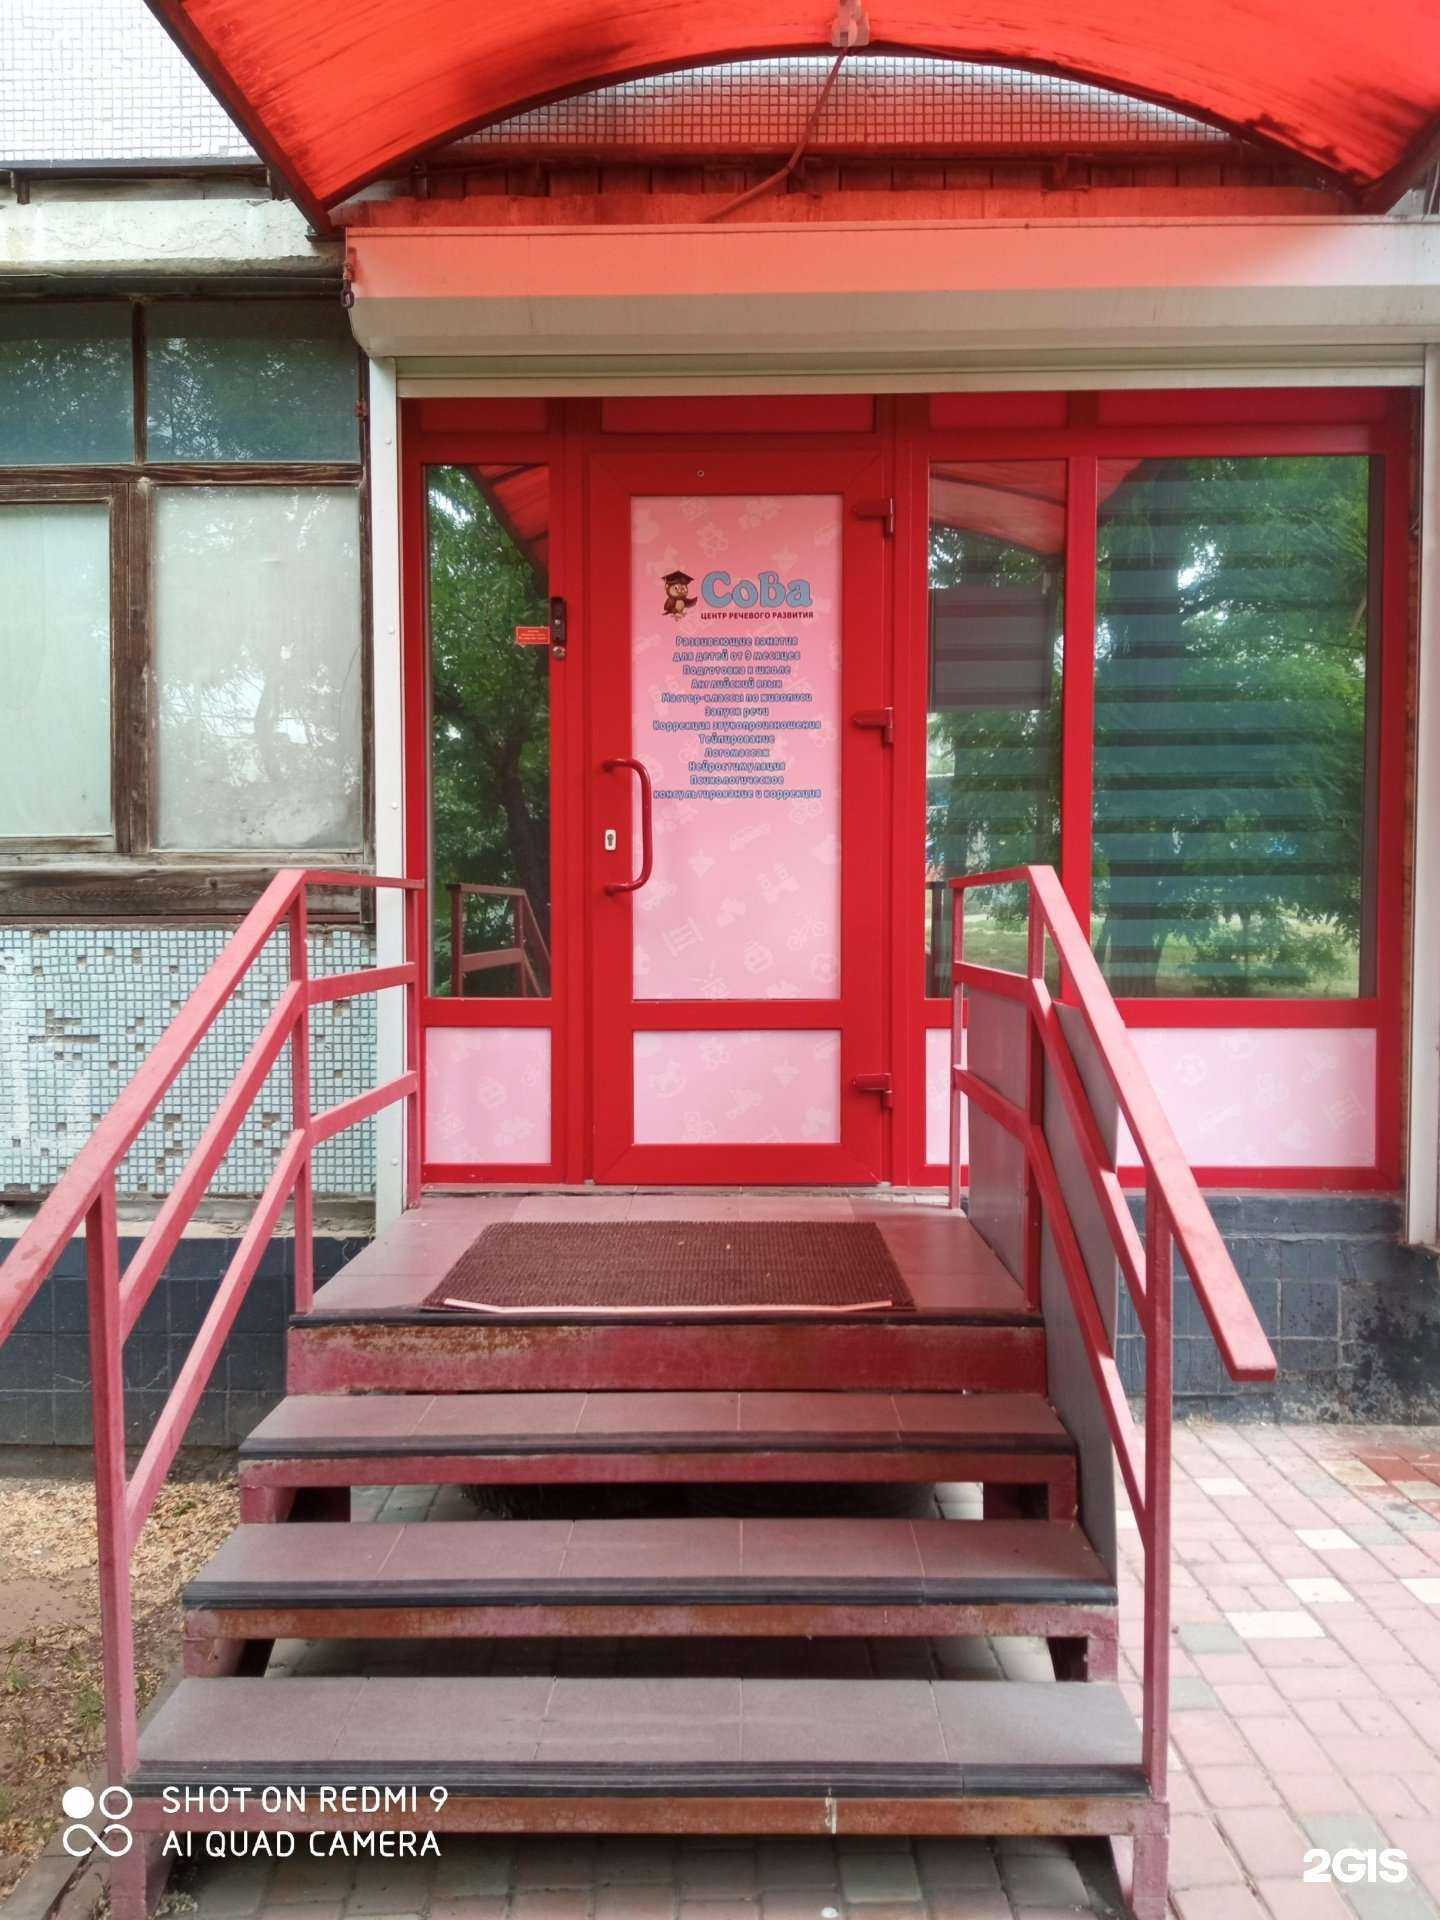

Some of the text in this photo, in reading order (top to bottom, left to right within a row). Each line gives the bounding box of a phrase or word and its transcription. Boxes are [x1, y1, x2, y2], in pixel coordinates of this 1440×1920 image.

[701, 612, 727, 620] ЦЕНТР
[772, 611, 814, 619] РАЗВИТИЯ
[676, 636, 798, 647] Развивающие занятия
[696, 649, 728, 662] детей
[730, 652, 743, 661] от
[745, 650, 752, 661] 9
[753, 651, 800, 662] месяцев
[683, 665, 791, 676] Подготовка к школе
[691, 677, 783, 689] Английский язык
[661, 693, 812, 704] Мастер-классы по живописи
[705, 706, 769, 717] Запуск речи
[652, 720, 822, 731] Коррекция звукопроизношения
[699, 733, 775, 745] Тейпирование
[704, 748, 770, 758] Логомассаж
[688, 761, 786, 772] Нейростимуляция
[690, 775, 785, 785] Психологическое
[654, 789, 822, 800] консультирование и коррекция
